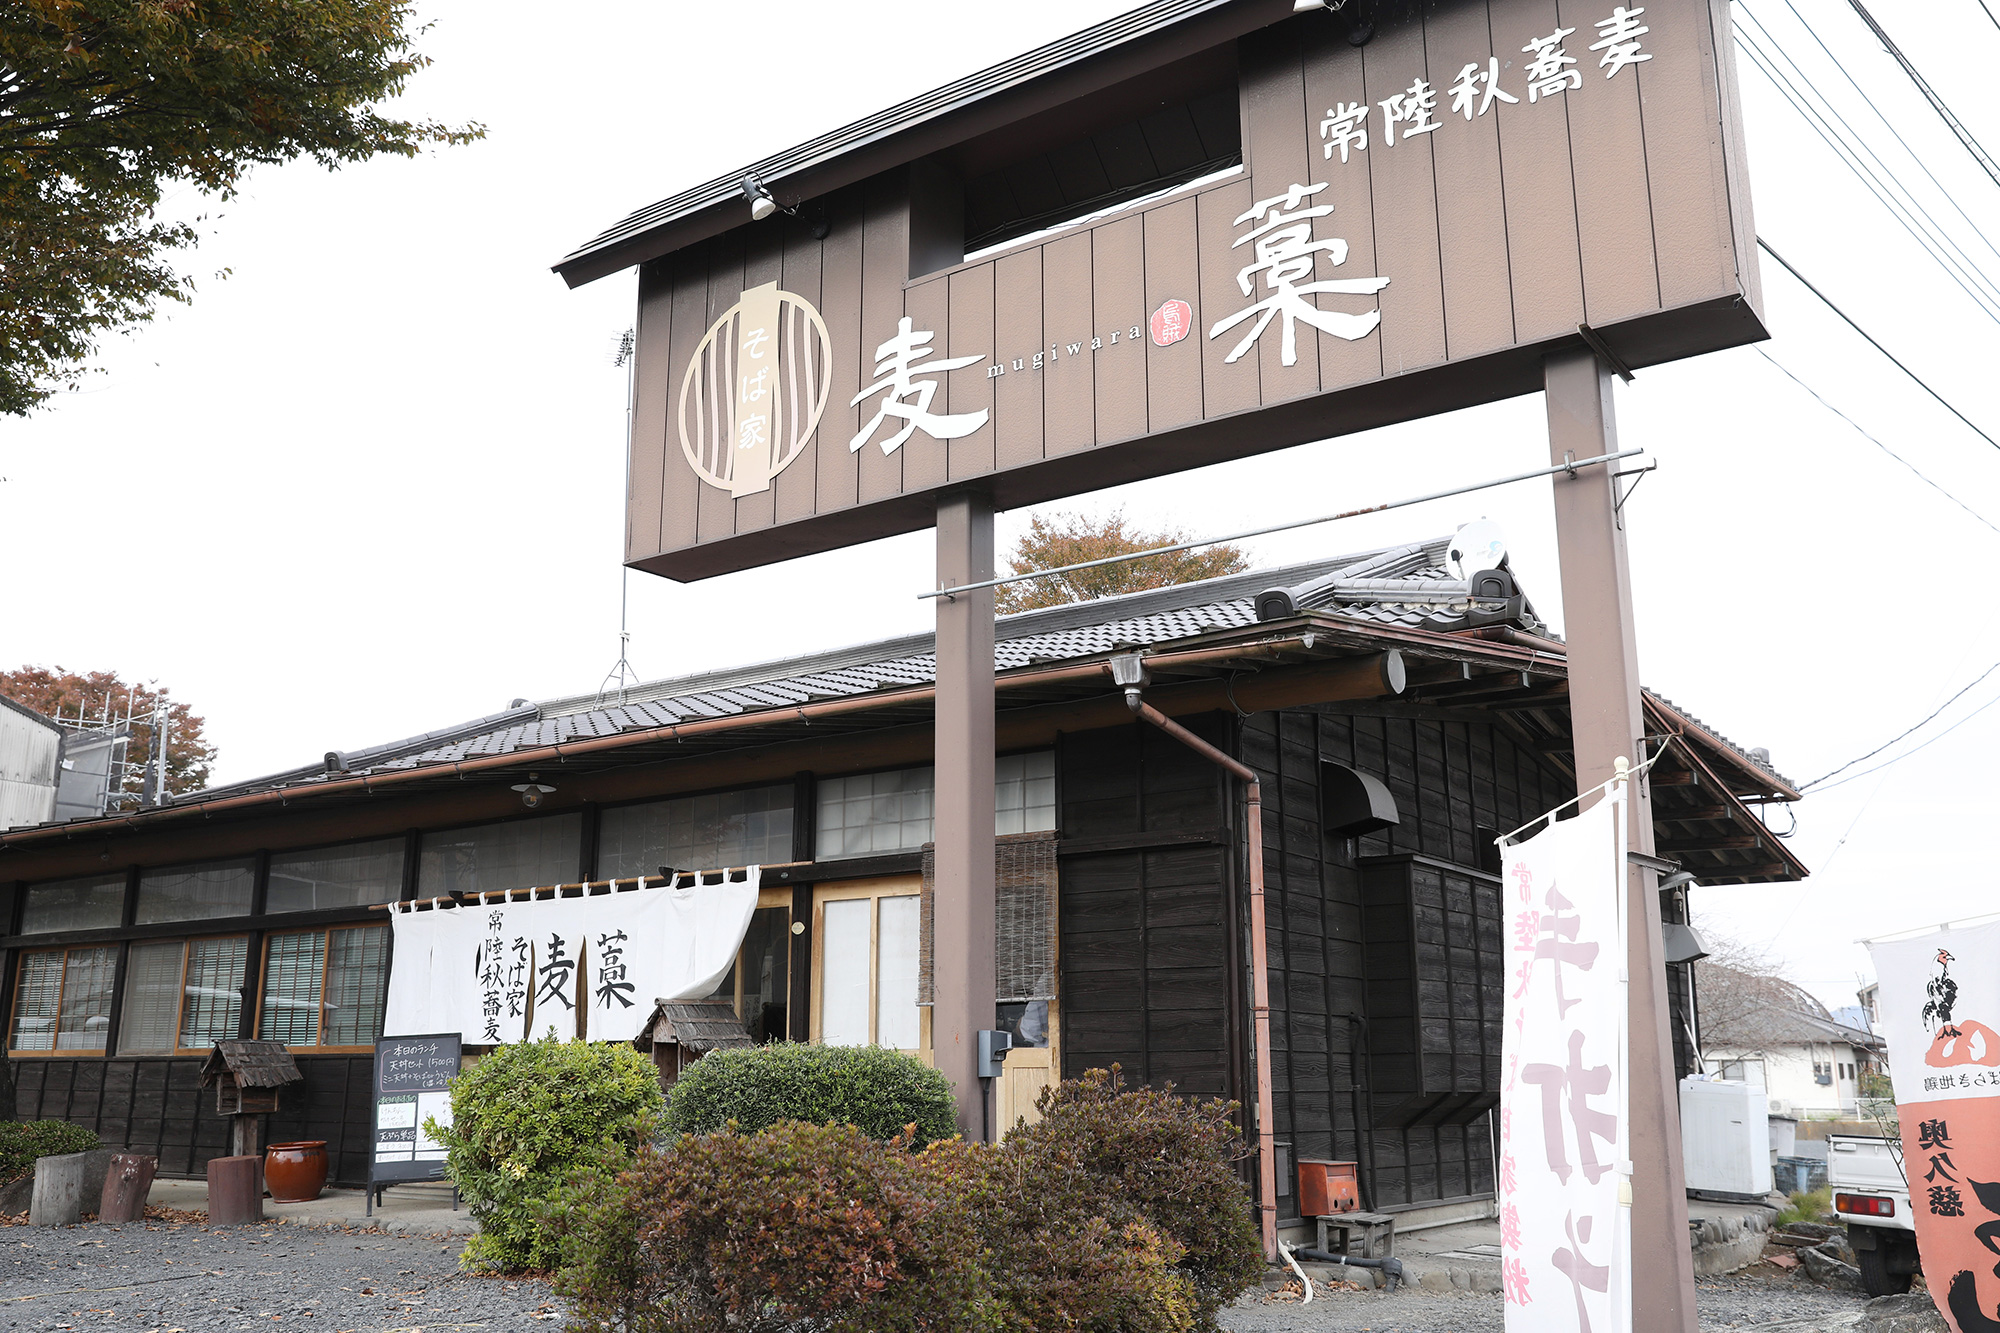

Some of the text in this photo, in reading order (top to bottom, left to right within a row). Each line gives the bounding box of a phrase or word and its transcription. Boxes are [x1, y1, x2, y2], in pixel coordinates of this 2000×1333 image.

[1319, 6, 1653, 164] 常陸秋蕎麦
[1209, 181, 1391, 367] 藁
[738, 328, 768, 450] そば家
[849, 316, 990, 456] 麦
[987, 324, 1143, 379] mugiwara
[480, 909, 504, 1042] 常陸秋蕎麦
[506, 936, 528, 1018] そば家
[389, 1057, 455, 1072] 天丼セット 1500円
[393, 1042, 439, 1057] 本日のランチ
